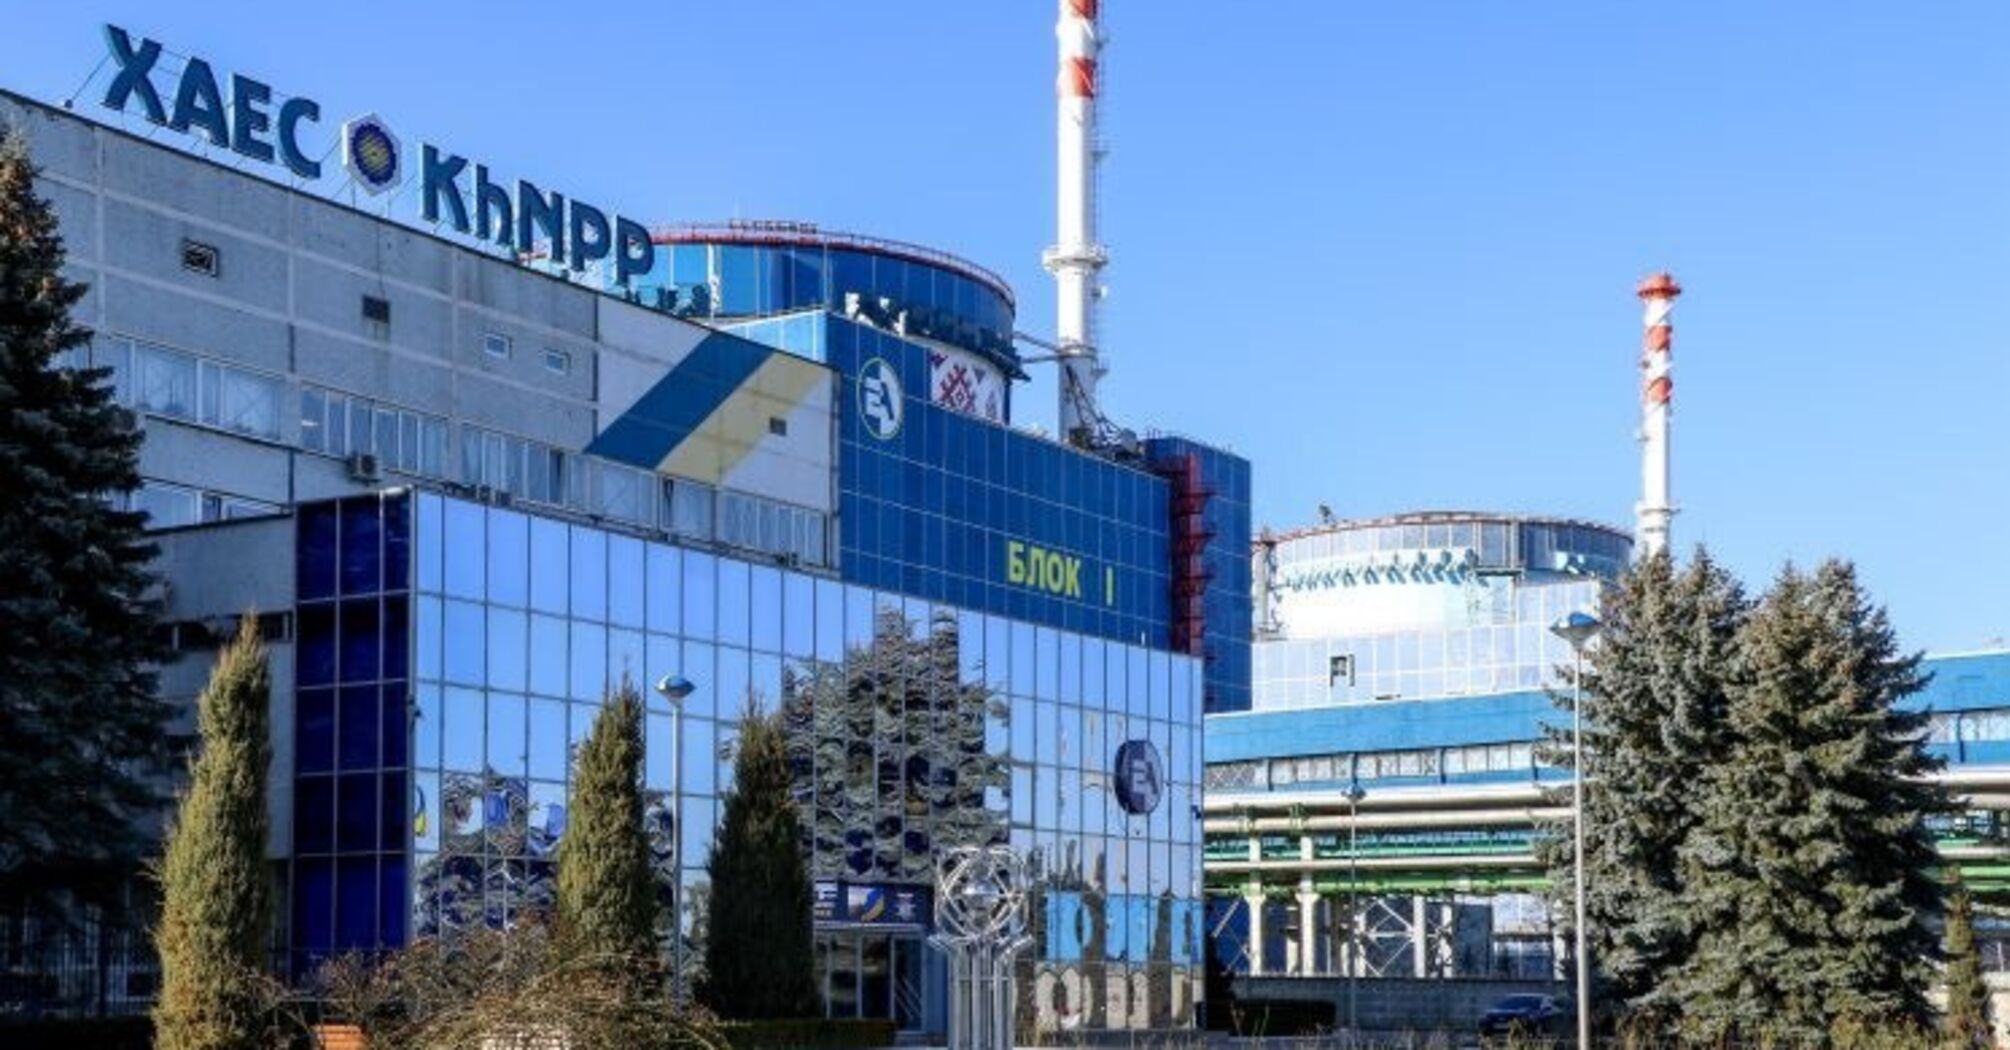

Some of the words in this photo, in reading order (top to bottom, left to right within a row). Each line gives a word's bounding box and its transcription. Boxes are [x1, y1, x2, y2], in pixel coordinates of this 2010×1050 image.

[101, 23, 321, 180] ХАЕС
[420, 142, 655, 287] KhNPP
[1008, 541, 1081, 599] БЛОК
